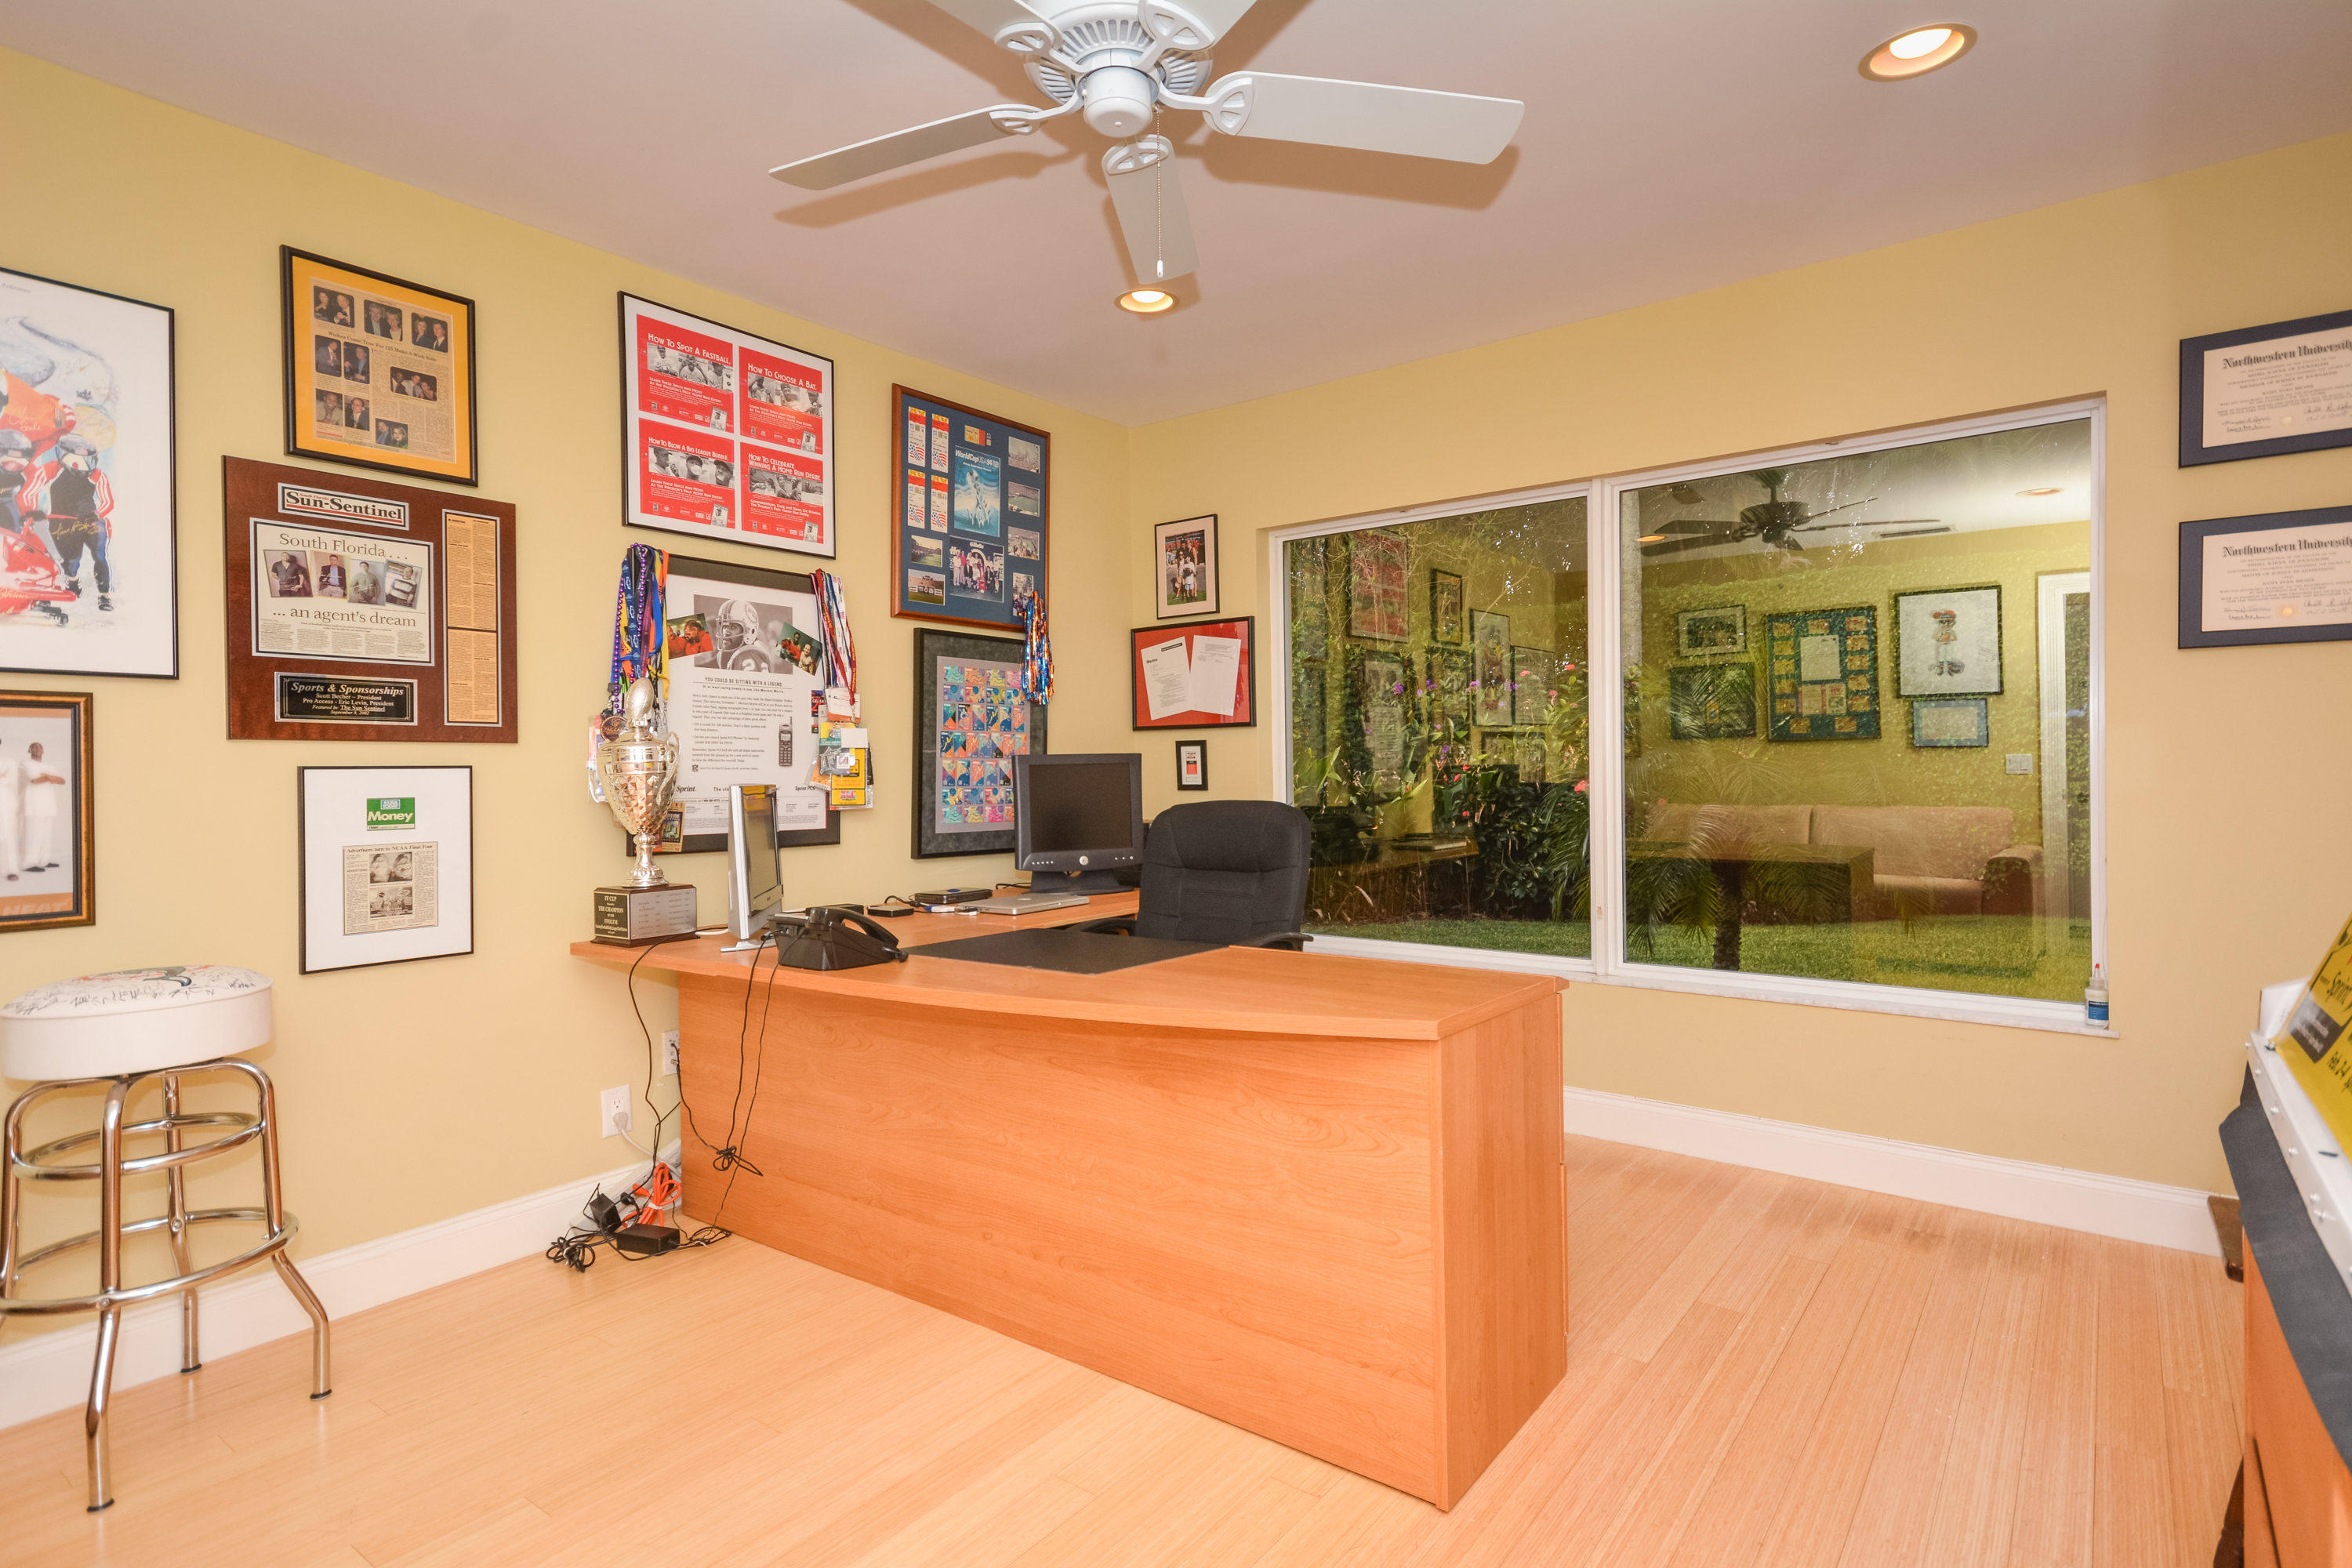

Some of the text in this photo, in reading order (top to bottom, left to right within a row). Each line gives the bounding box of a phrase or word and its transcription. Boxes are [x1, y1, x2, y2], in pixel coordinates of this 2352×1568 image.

[2223, 350, 2296, 369] Northwestern
[286, 491, 401, 519] Sun-Sentinel
[280, 533, 327, 550] South
[2223, 543, 2296, 557] Northwestern
[290, 608, 310, 619] an
[314, 608, 366, 624] agent's
[369, 612, 416, 627] dream
[291, 682, 324, 692] Sports
[339, 684, 404, 695] Sponsorships
[368, 811, 413, 822] Money
